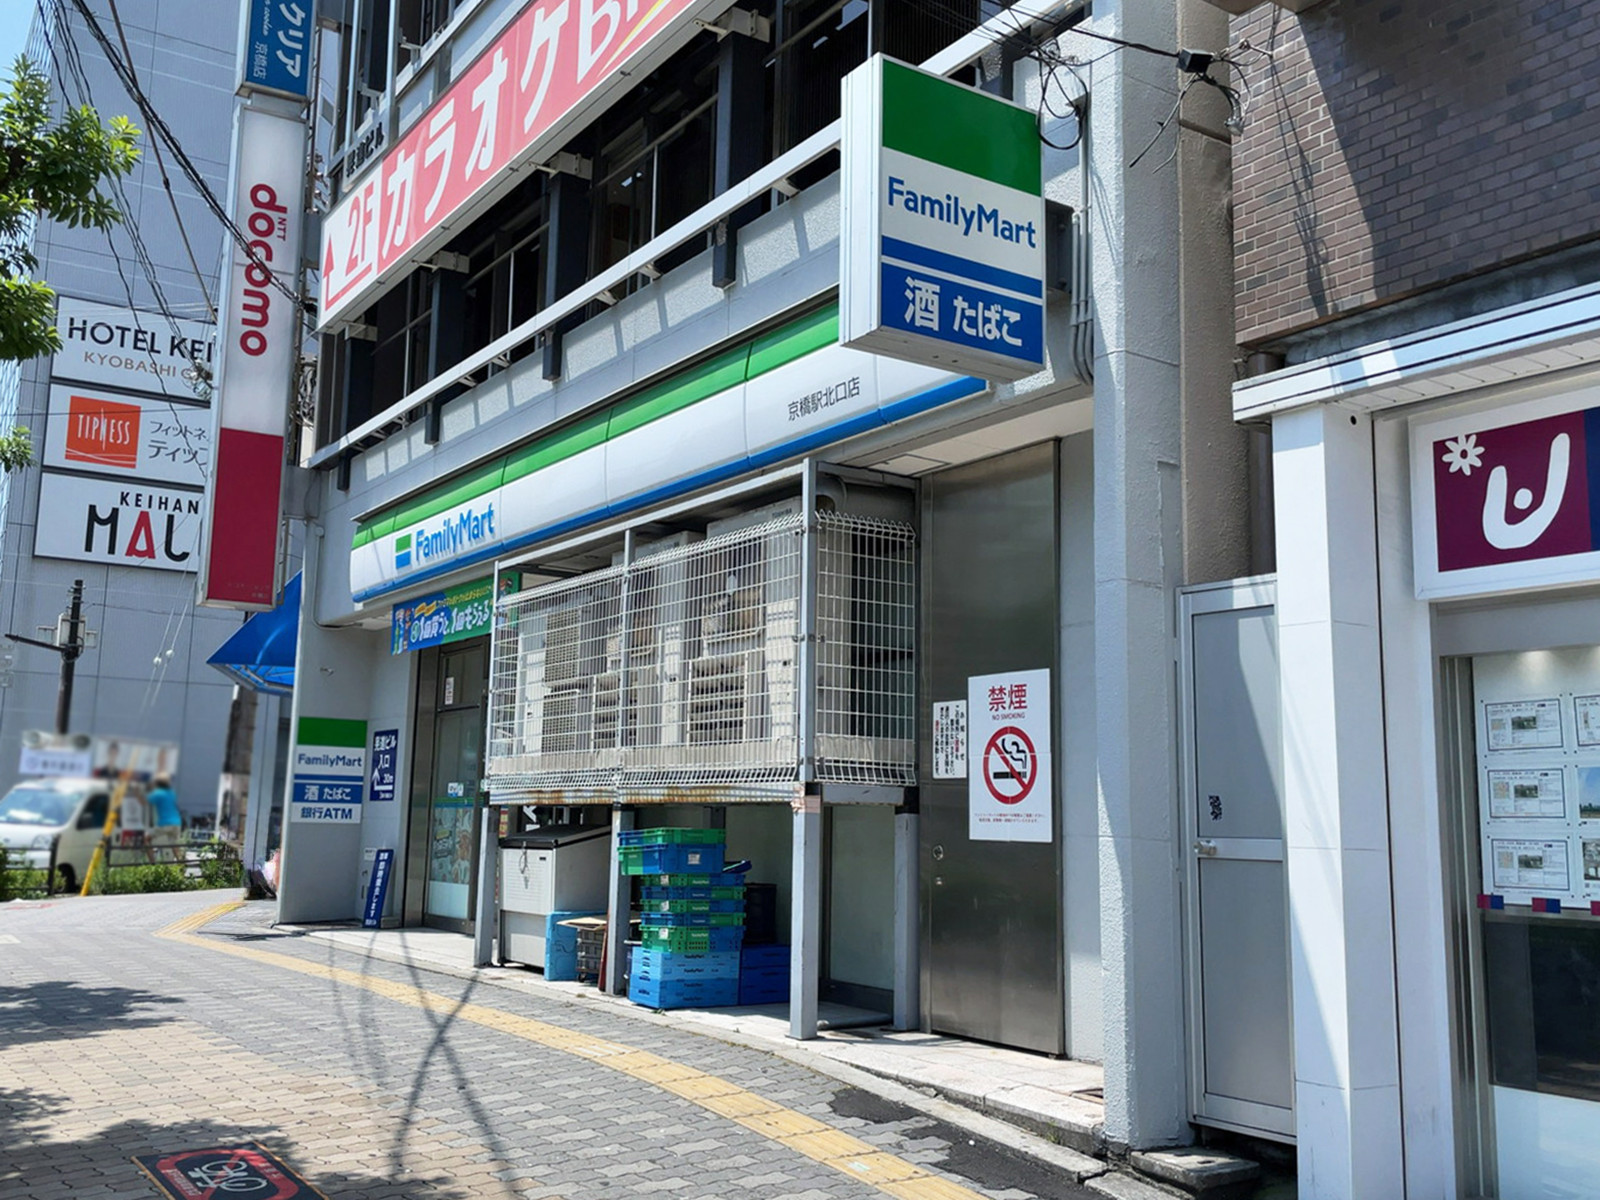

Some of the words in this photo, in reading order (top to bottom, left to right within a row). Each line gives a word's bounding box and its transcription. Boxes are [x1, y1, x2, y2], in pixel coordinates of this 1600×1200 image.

[276, 2, 306, 78] クリア
[277, 217, 287, 242] NTT
[346, 182, 375, 277] 2F
[888, 176, 1036, 249] FamilyMart
[240, 183, 288, 357] docomo
[903, 276, 940, 333] 酒
[953, 294, 1023, 347] たばこ
[68, 317, 161, 354] HOTEL
[84, 351, 176, 377] KYOBASHI
[788, 376, 860, 421] 京橋駅北口店
[77, 407, 131, 451] TIPNESS
[120, 491, 200, 515] KEIHAN
[85, 504, 203, 562] MAL
[415, 502, 494, 562] FamilyMart
[988, 684, 1028, 712] 禁煙
[1001, 712, 1025, 720] SMOKING
[298, 753, 362, 767] FamilyMart
[304, 784, 320, 801] 酒
[323, 787, 351, 801] たばこ
[301, 807, 353, 820] 銀行ATM
